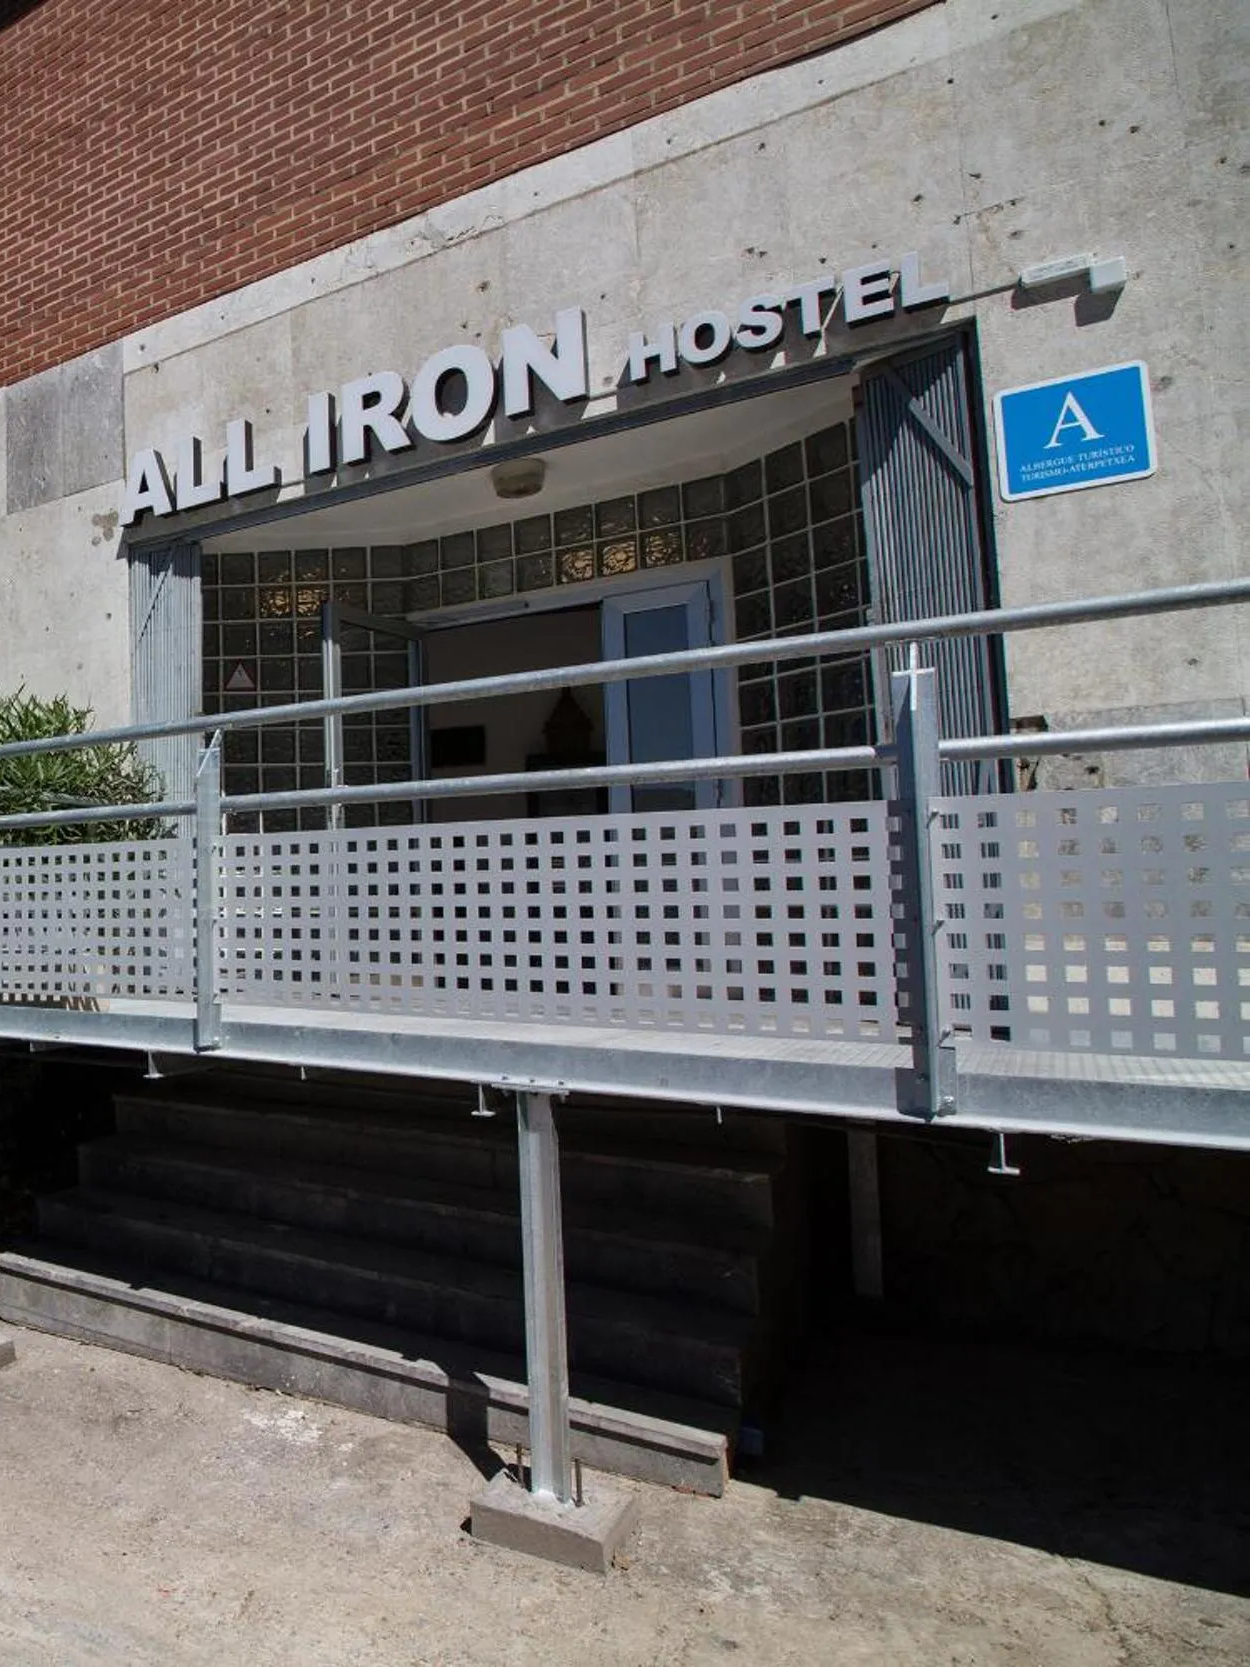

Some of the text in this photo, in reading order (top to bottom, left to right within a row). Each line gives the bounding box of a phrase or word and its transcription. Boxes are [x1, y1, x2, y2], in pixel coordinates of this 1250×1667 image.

[118, 250, 950, 527] ALL IRON HOSTEL
[1043, 391, 1105, 449] A
